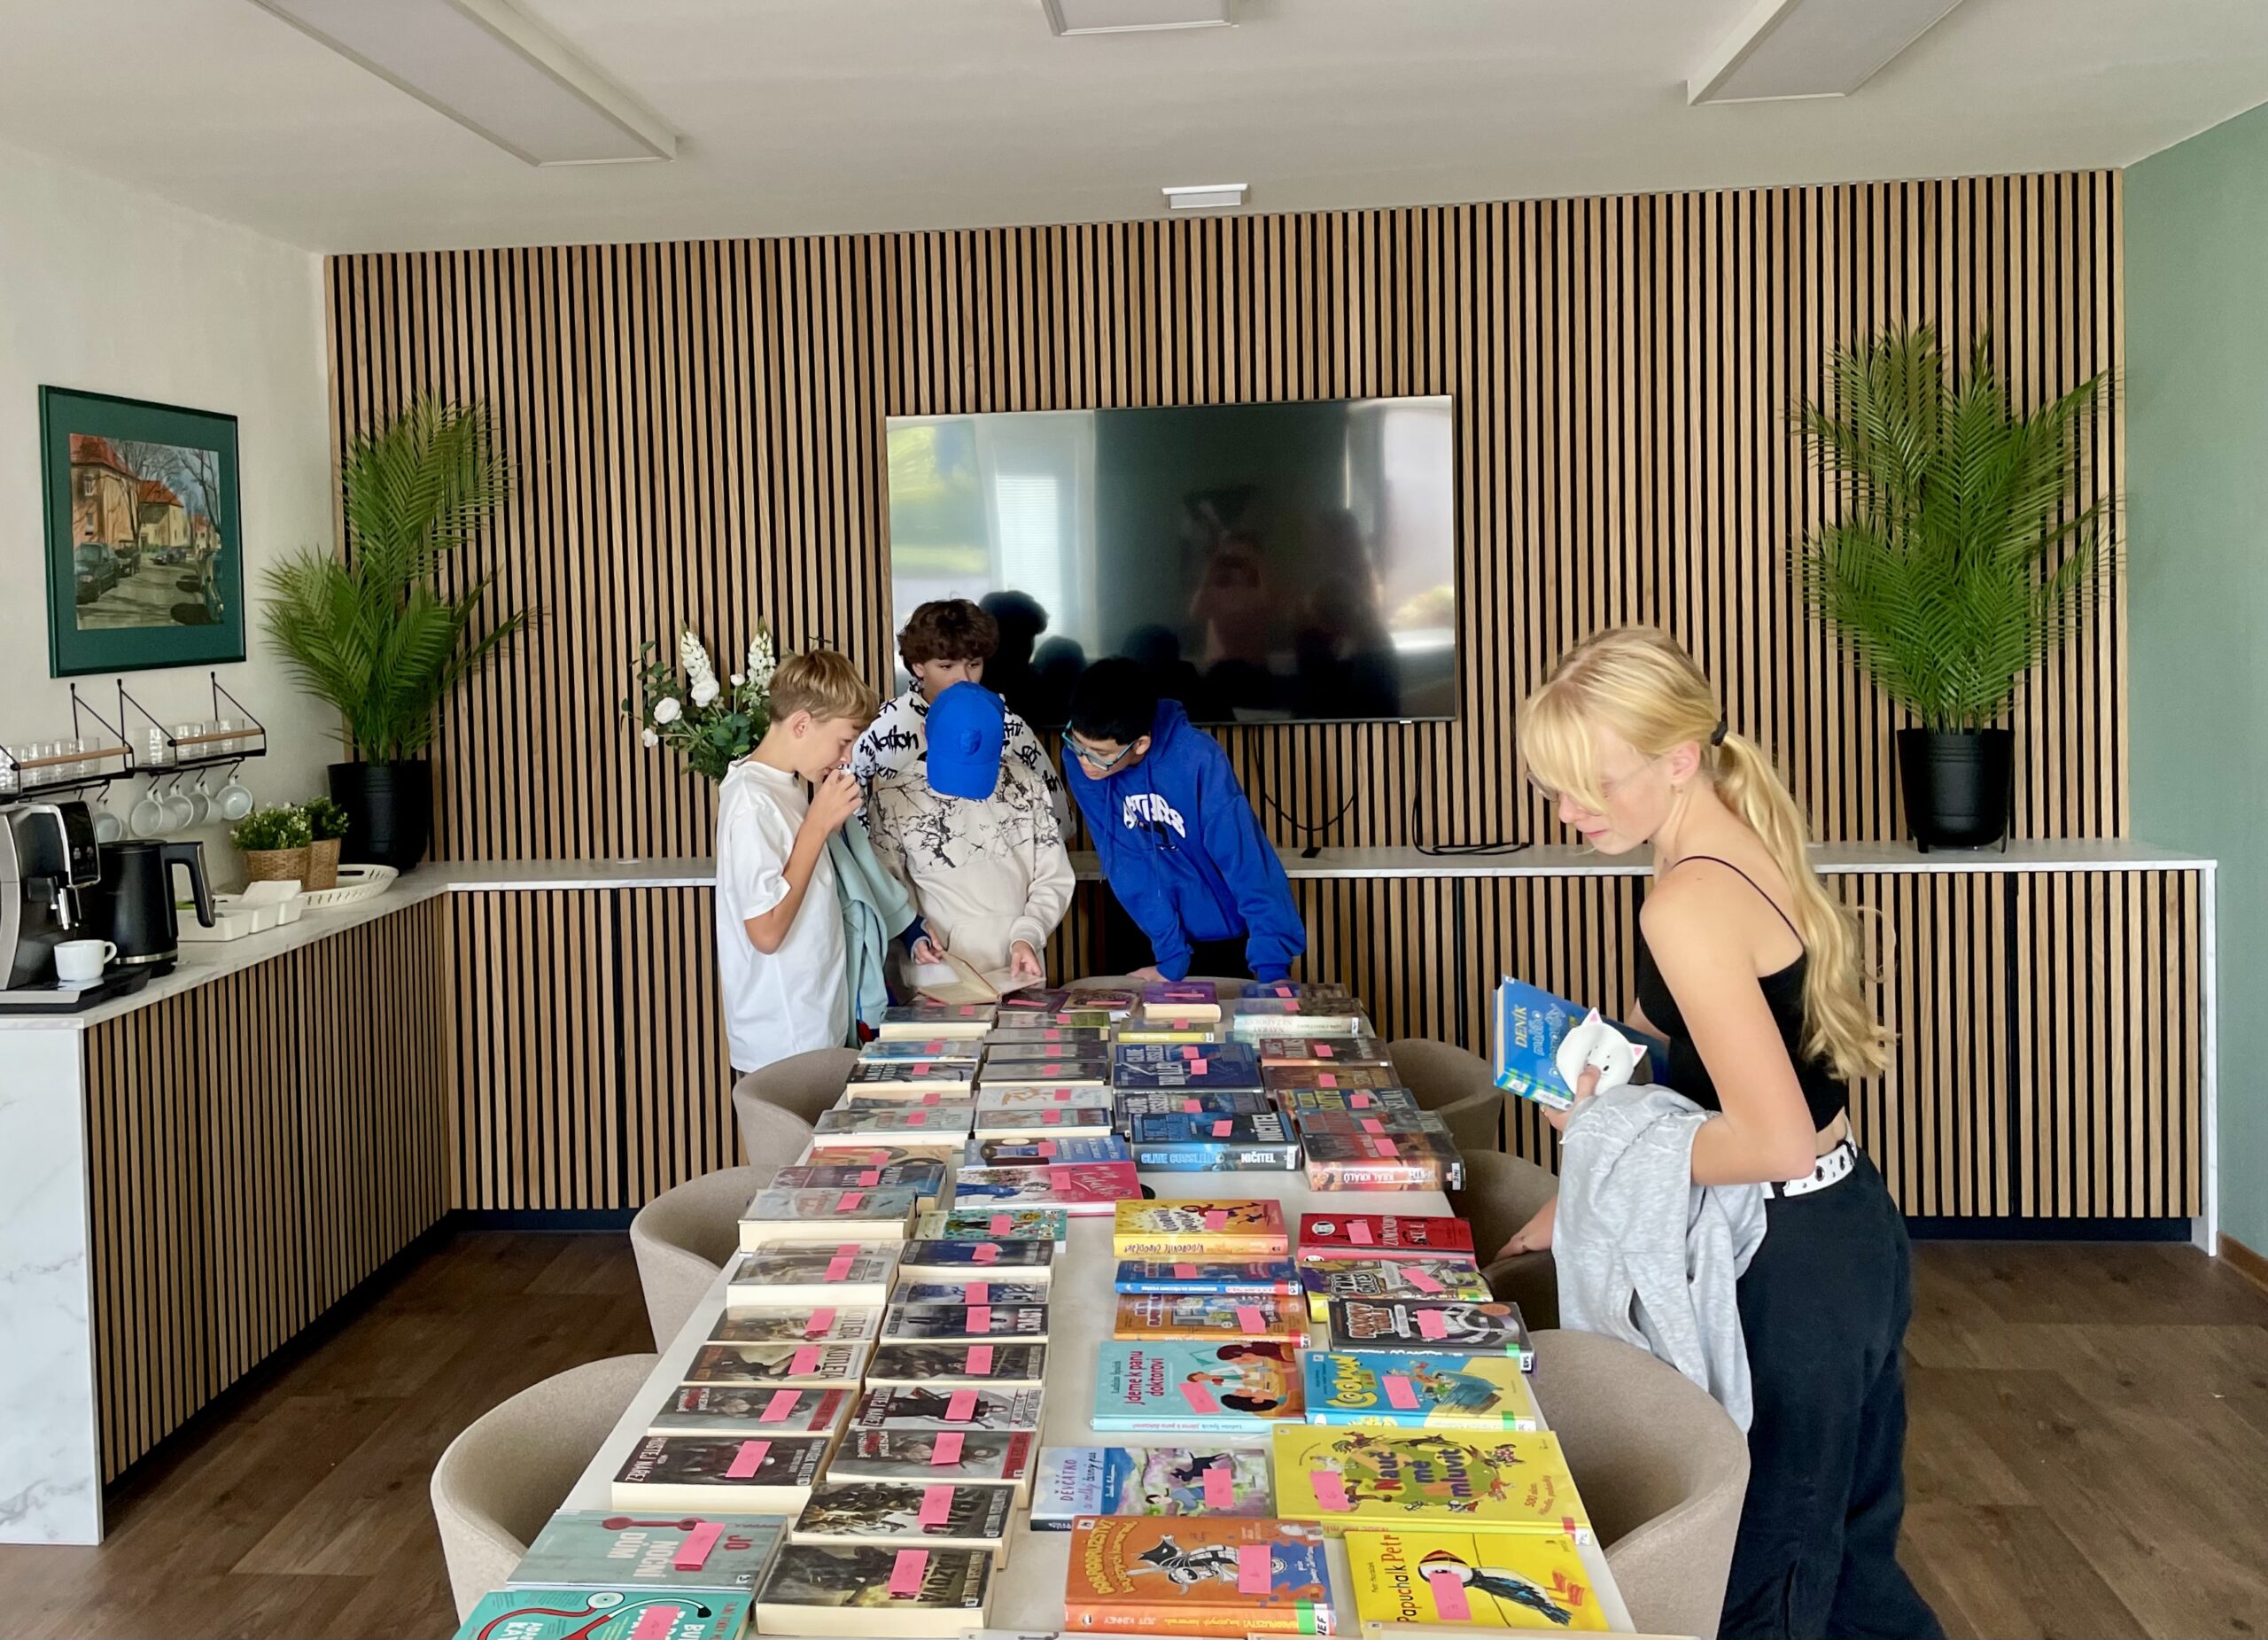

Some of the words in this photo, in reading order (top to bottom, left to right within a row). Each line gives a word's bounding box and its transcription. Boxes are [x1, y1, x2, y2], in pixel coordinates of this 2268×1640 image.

[1511, 1003, 1527, 1047] DENÍK
[1241, 1152, 1276, 1163] NIČITEL
[1343, 1173, 1371, 1183] KRÁLŮ
[1332, 1274, 1351, 1293] TOM
[1352, 1274, 1377, 1294] GATES
[1129, 1351, 1148, 1370] panu
[1144, 1358, 1165, 1396] doktorovi
[1123, 1379, 1146, 1405] Jdeme
[1054, 1459, 1077, 1501] DĚVČÁTKO
[1368, 1451, 1402, 1490] Nauč
[1403, 1460, 1434, 1483] mě
[1435, 1449, 1472, 1497] mluvit
[607, 1532, 650, 1558] DŮM
[723, 1535, 753, 1551] JO
[1379, 1535, 1404, 1562] Petr
[1385, 1565, 1423, 1622] Papuchalk
